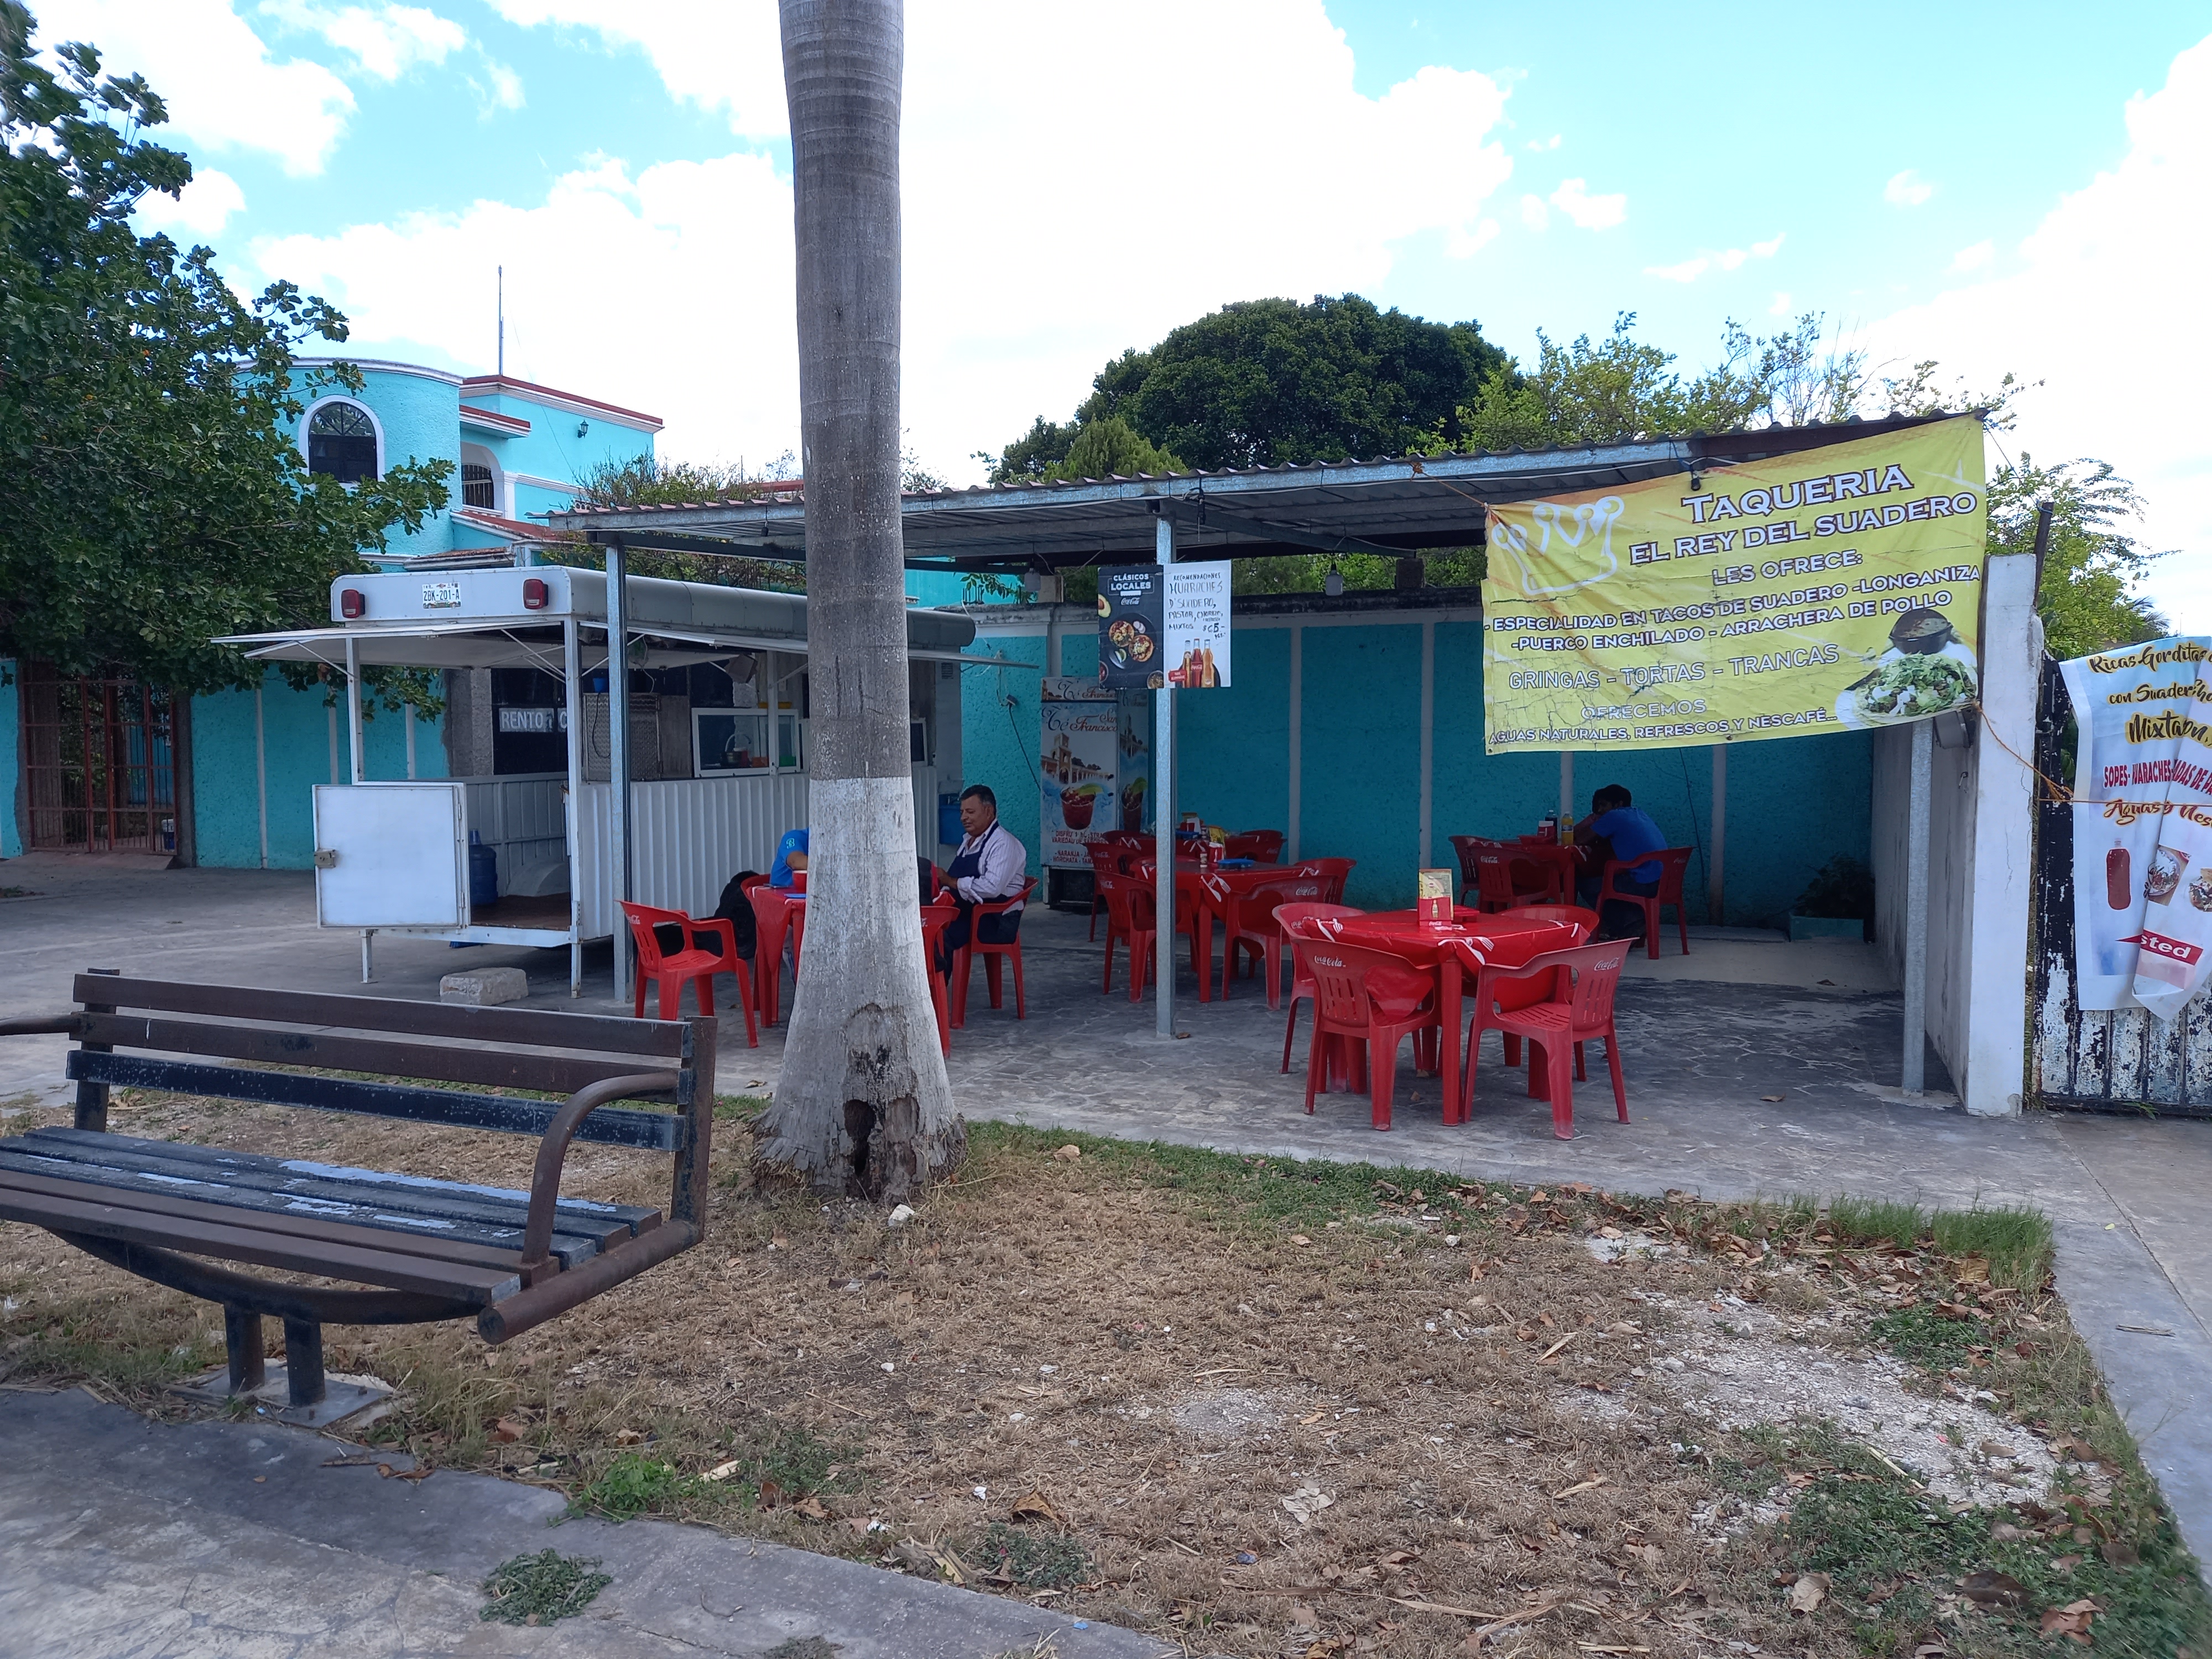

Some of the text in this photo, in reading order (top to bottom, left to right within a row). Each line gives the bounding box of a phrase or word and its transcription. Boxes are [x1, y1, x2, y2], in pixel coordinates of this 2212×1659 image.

[1682, 463, 1915, 524] TAQUERIA
[1629, 492, 1978, 565] EL REY DEL SUADERO
[1113, 573, 1149, 581] CLÁSICOS
[1173, 572, 1221, 581] RECOMENDACIONES
[1712, 549, 1863, 586] LES OFRECE:
[423, 588, 460, 601] 2BK-201-A
[1110, 581, 1151, 591] LOCALES
[1169, 580, 1223, 594] HUARACHES
[1493, 614, 1618, 632] ESPECIALIDAD
[1621, 610, 1647, 626] EN
[1651, 605, 1715, 623] TACOS
[1718, 600, 1746, 616] DE
[1750, 583, 1848, 612] SUADERO
[1592, 627, 1705, 649] ENCHILADO
[1721, 608, 1844, 638] ARRACHERA
[1849, 601, 1876, 618] DE
[1882, 591, 1953, 614] POLLO
[1509, 670, 1601, 690] GRINGAS
[1620, 661, 1706, 686] TORTAS
[1729, 644, 1840, 676] TRANCAS
[2089, 655, 2137, 674] Ricas
[1580, 698, 1707, 721] OFRECEMOS
[2109, 692, 2132, 705] con
[501, 711, 544, 729] RENTO
[1489, 727, 1536, 744] AGUAS
[1540, 726, 1632, 741] NATURALES,
[1634, 721, 1730, 738] REFRESCOS
[1733, 719, 1744, 731] Y
[2189, 767, 2209, 790] DE
[2103, 798, 2161, 825] Aguas
